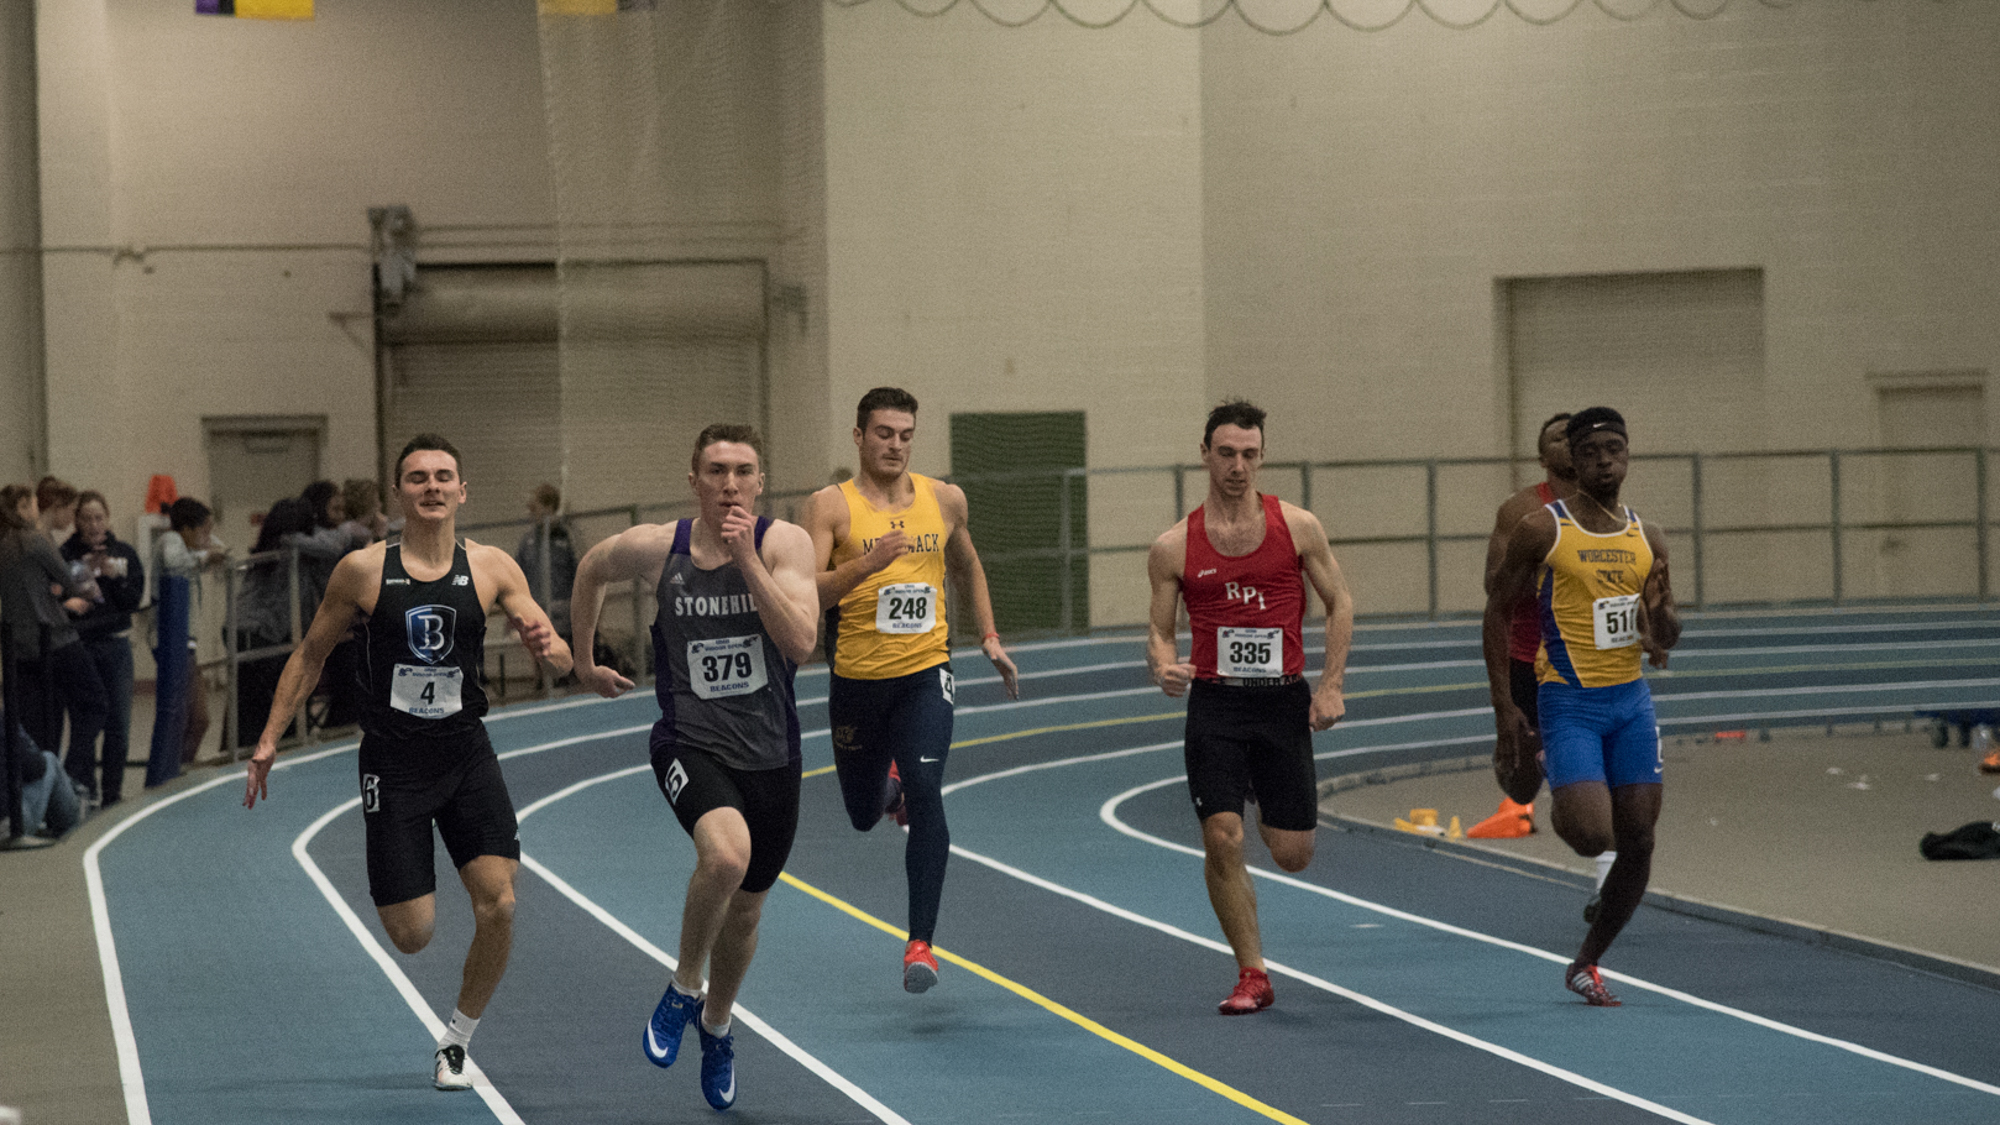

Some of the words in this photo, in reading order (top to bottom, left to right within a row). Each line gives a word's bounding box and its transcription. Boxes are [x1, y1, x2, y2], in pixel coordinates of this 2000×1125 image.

[1577, 549, 1636, 565] WORCESTER
[1596, 569, 1624, 584] STATE
[675, 593, 758, 616] STONEHIL
[1225, 581, 1267, 610] RPI
[889, 597, 927, 620] 248
[417, 614, 445, 650] B
[1229, 641, 1271, 665] 335
[702, 652, 752, 682] 379
[420, 681, 435, 705] 4
[710, 682, 749, 692] BEACONS
[409, 706, 445, 715] BEACONS
[365, 776, 376, 809] 6
